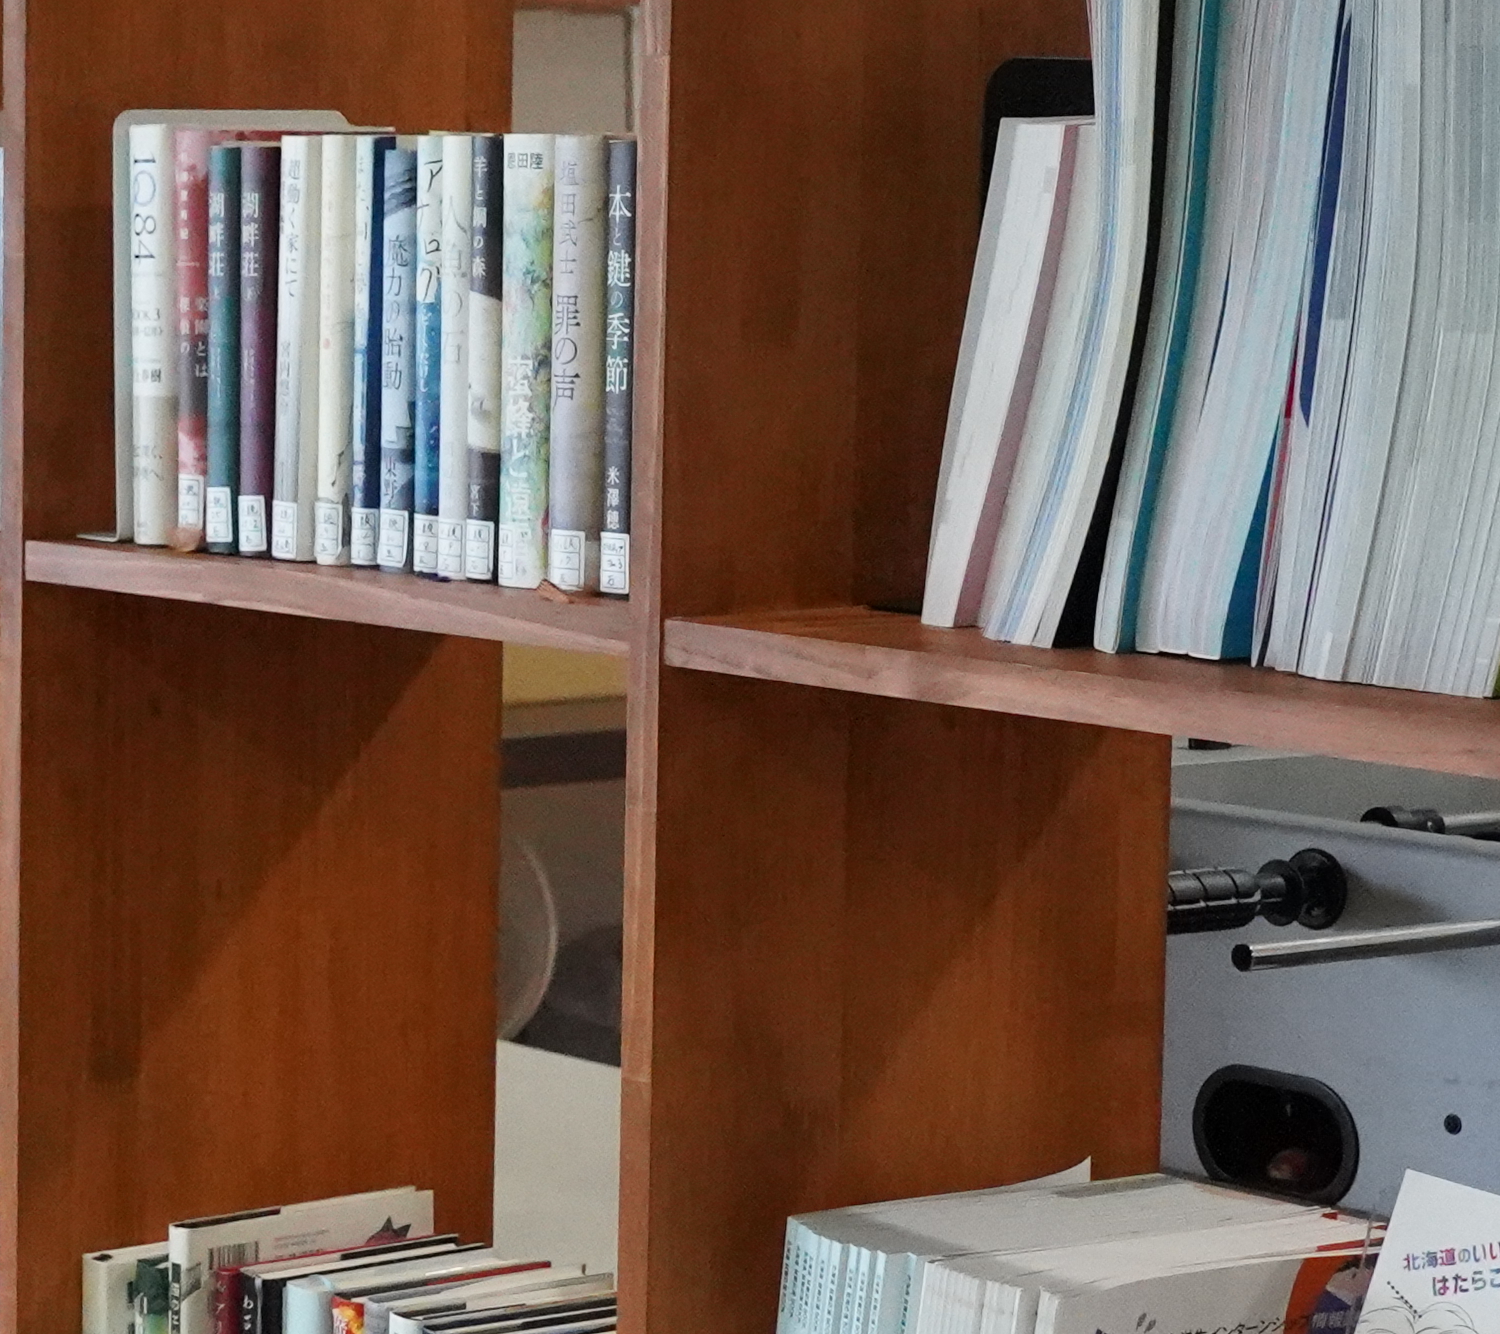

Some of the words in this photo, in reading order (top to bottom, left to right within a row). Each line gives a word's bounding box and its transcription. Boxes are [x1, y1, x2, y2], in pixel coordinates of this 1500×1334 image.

[471, 155, 489, 278] 羊と鋼の森
[558, 160, 580, 276] 塩田武士
[383, 236, 409, 392] 魔力の胎動
[553, 293, 582, 406] 罪の声
[605, 184, 632, 395] 本と鍵の季節
